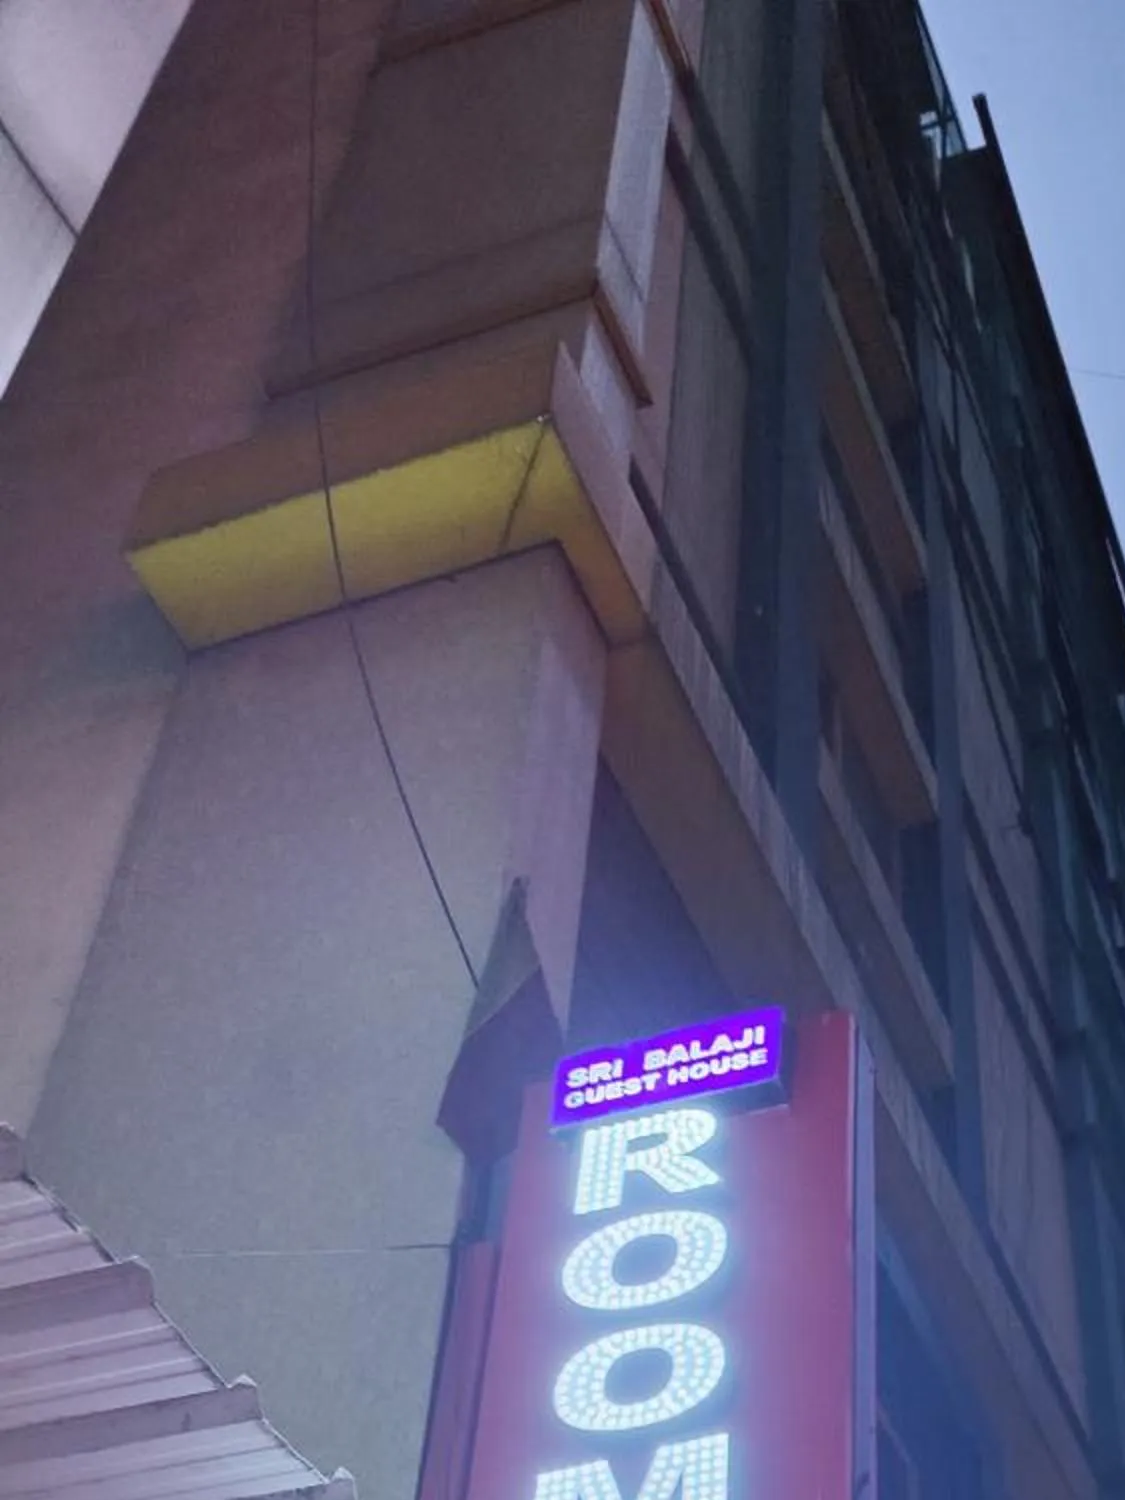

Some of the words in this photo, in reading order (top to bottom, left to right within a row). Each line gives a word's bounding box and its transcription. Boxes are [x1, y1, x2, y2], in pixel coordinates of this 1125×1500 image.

[563, 1073, 660, 1109] GUEST
[667, 1048, 769, 1087] HOUSE
[566, 1059, 623, 1089] SRI
[643, 1025, 765, 1071] BALAJI
